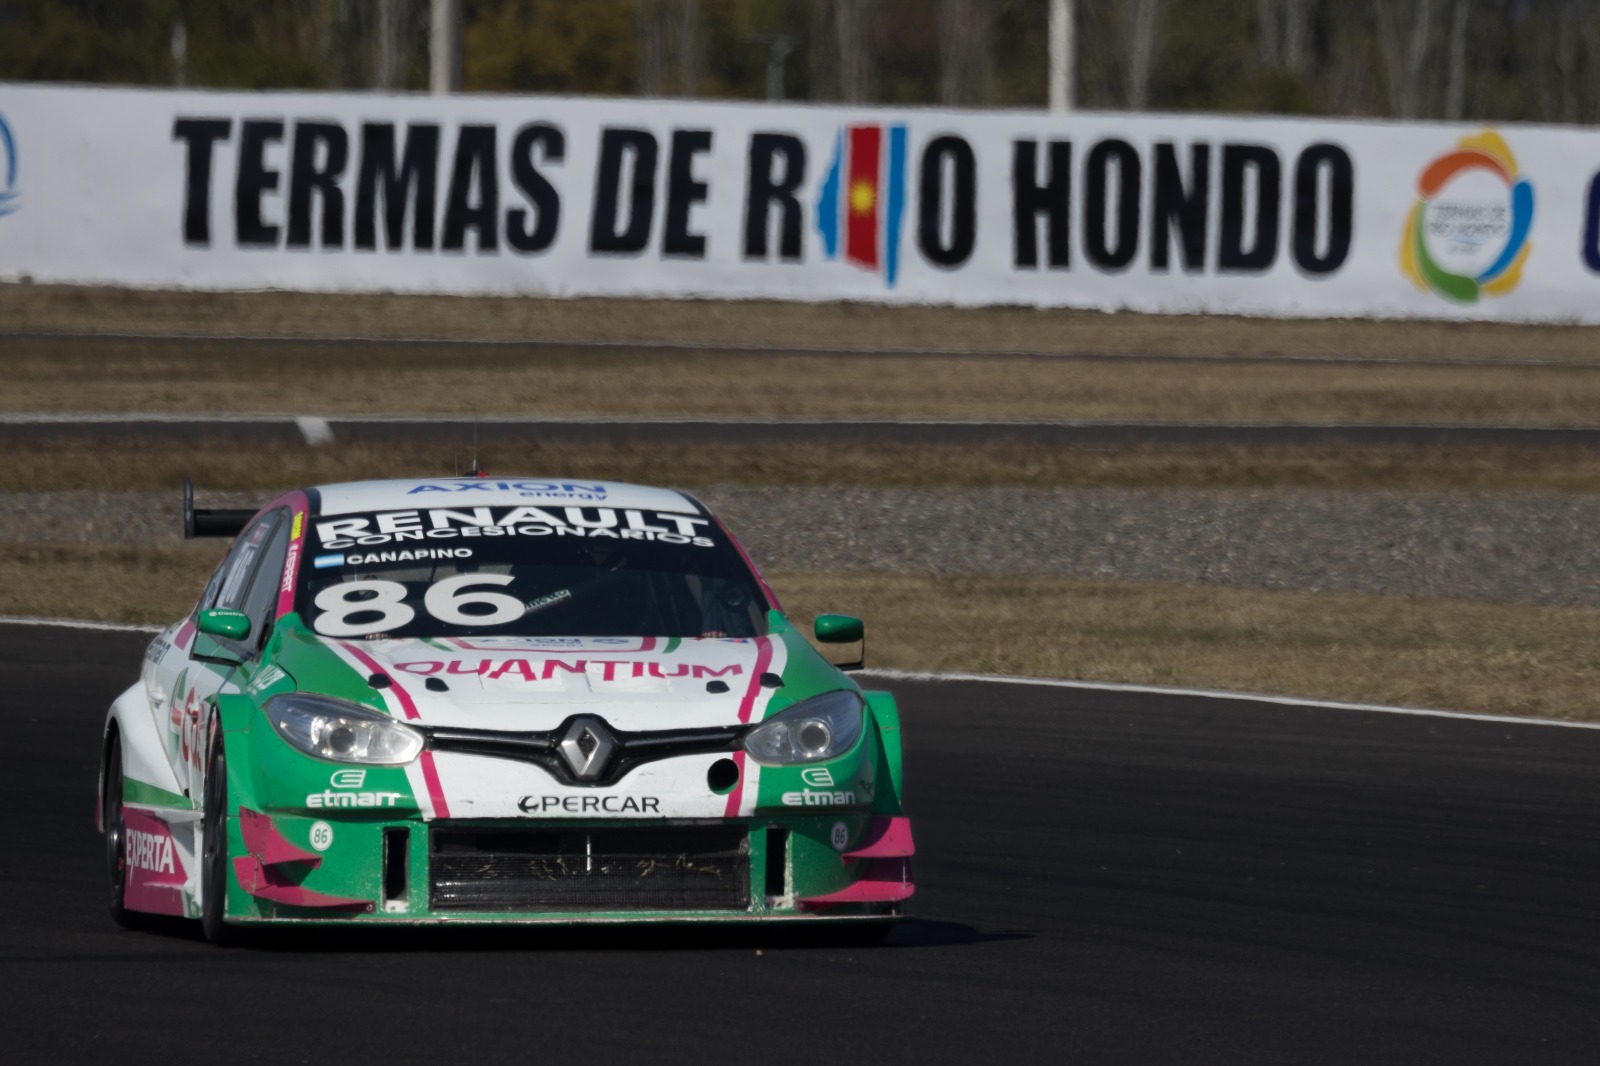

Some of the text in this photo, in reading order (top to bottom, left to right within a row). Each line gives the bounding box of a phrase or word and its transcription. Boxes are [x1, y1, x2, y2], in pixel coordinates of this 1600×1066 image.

[173, 116, 567, 255] TERMAS
[589, 124, 712, 259] DE
[1012, 137, 1355, 278] HONDO
[406, 481, 608, 495] AXION
[519, 491, 608, 501] energy
[316, 507, 709, 542] RENAULT
[322, 526, 715, 550] CONCESIONARIOS
[347, 548, 473, 566] CANAPINO
[313, 573, 526, 637] 86
[394, 659, 744, 682] QUANTIUM
[782, 788, 856, 806] etman
[314, 828, 328, 844] 86
[834, 828, 845, 845] 86
[126, 828, 175, 886] EXPERTA
